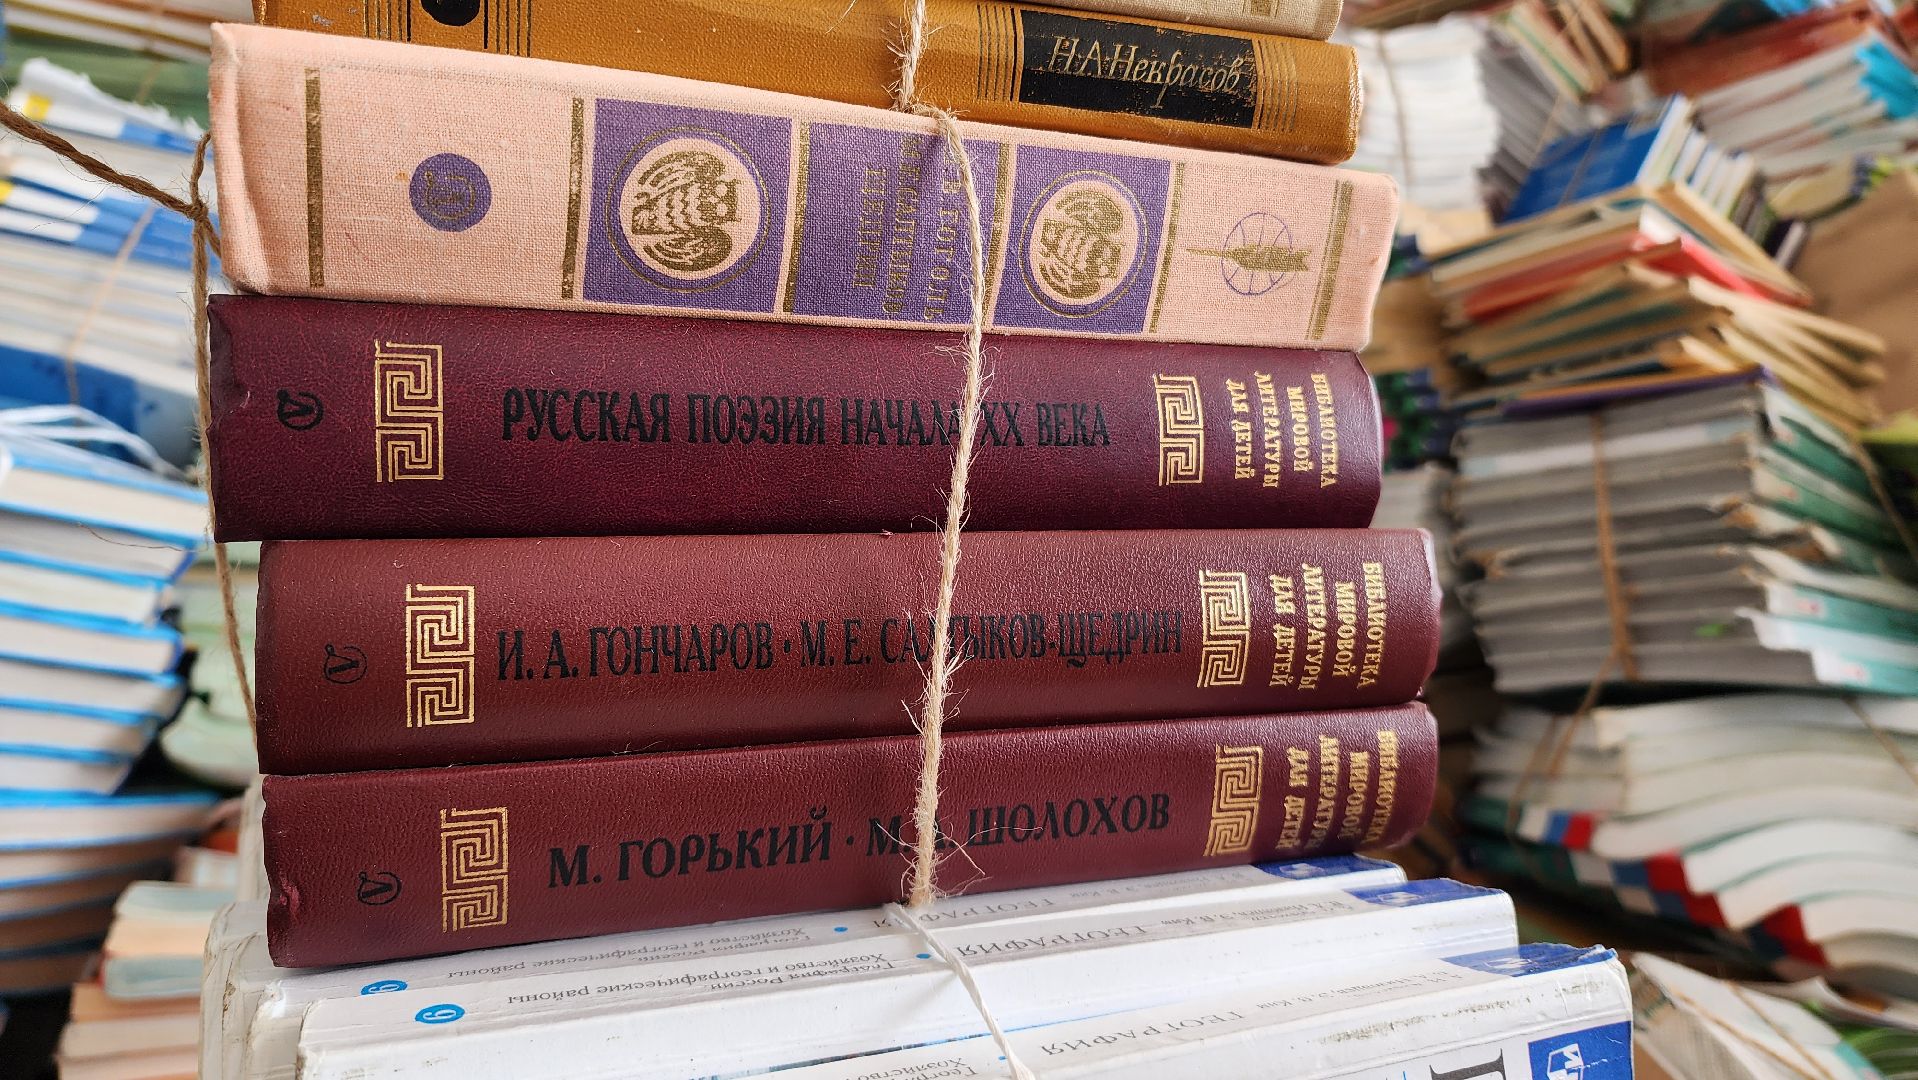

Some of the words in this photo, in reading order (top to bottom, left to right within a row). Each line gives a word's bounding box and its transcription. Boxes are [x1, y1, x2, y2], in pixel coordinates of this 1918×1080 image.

[502, 387, 671, 442] РУССКАЯ
[687, 392, 826, 445] ПОЭЗИЯ
[1036, 401, 1110, 447] ВЕКА
[1226, 378, 1249, 413] ДЛЯ
[1231, 419, 1256, 480] ДЕТЕЙ
[1254, 371, 1281, 488] ЛИТЕРАТУРЫ
[1287, 386, 1314, 472] МИРОВОЙ
[1311, 373, 1338, 489] БИБЛИОТЕКА
[1268, 574, 1296, 615] ДЛЯ
[497, 630, 534, 680] И.
[543, 628, 579, 679] А.
[588, 620, 774, 677] ГОНЧАРОВ
[800, 619, 835, 668] М.
[843, 617, 871, 666] Е.
[1269, 623, 1297, 688] ДЕТЕЙ
[1298, 563, 1328, 691] ЛИТЕРАТУРЫ
[1332, 581, 1357, 677] МИРОВОЙ
[1356, 561, 1387, 690] БИБЛИОТЕКА
[1287, 746, 1309, 787] ДЛЯ
[1304, 734, 1340, 849] ЛИТЕРАТУРЫ
[1338, 751, 1369, 838] МИРОВОЙ
[1361, 729, 1398, 844] БИБЛИОТЕКА
[548, 844, 602, 888] М.
[617, 804, 832, 882] ГОРЬКИЙ
[967, 793, 1170, 849] ШОЛОХОВ
[1275, 795, 1305, 849] ДЕТЕЙ
[872, 898, 1056, 928] ГЕОГРАФЯ
[956, 925, 1148, 957] ГЕОГРАФИЯ
[448, 961, 526, 979] районы
[597, 966, 761, 993] географические
[767, 965, 780, 974] и
[785, 952, 888, 971] Хозяйство
[508, 985, 589, 1004] районы
[1040, 1011, 1245, 1056] ГЕОГРАФИЯ
